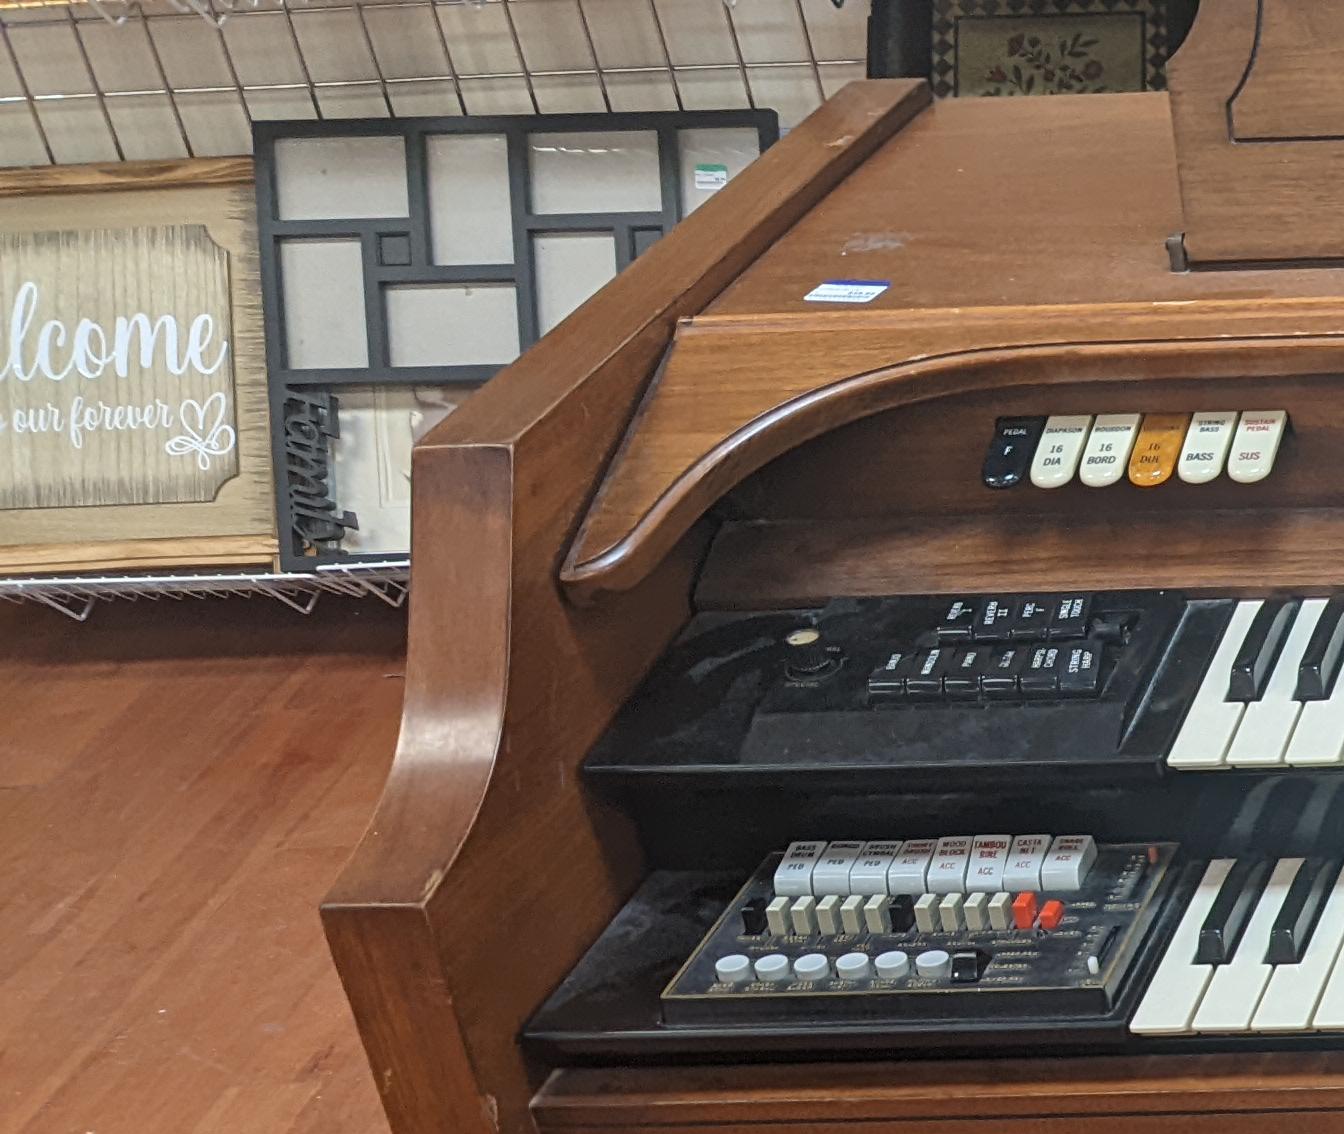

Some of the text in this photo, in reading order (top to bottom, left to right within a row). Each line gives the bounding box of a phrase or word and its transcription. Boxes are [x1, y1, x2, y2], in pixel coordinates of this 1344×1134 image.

[0, 282, 227, 381] lcome
[13, 396, 173, 449] our forever
[1003, 428, 1027, 436] PEDAL
[1003, 446, 1013, 455] F
[1050, 444, 1063, 454] 16
[1098, 443, 1113, 452] 16
[1086, 455, 1117, 465] BORD
[1186, 452, 1214, 461] BASS
[1238, 451, 1260, 461] SUS
[1042, 457, 1061, 466] DIA
[1017, 839, 1042, 847] CASTA
[939, 862, 956, 870] ACC
[1015, 861, 1031, 869] ACC
[978, 867, 994, 875] ACC
